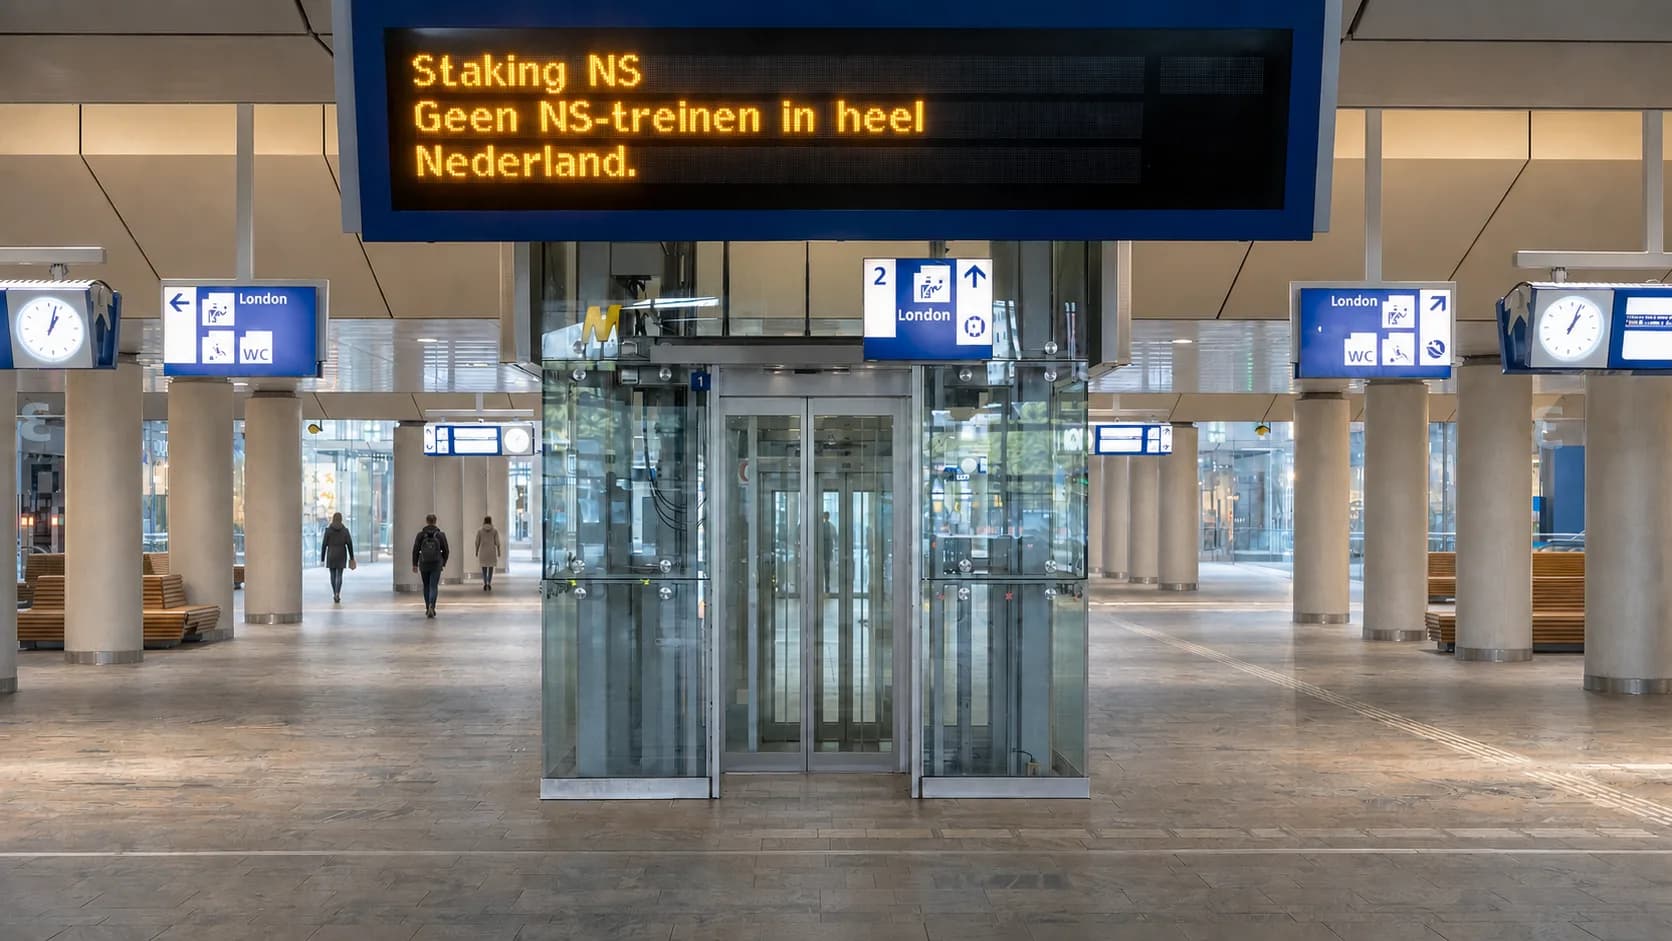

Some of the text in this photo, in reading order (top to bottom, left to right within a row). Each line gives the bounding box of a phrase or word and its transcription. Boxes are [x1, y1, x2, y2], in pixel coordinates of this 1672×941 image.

[413, 53, 641, 92] Staking NS
[413, 100, 925, 133] Geen NS-treinen in heel
[415, 144, 637, 177] Nederland.
[873, 266, 887, 286] 2
[239, 292, 288, 305] London
[1331, 294, 1378, 307] London
[898, 307, 951, 322] London
[243, 348, 268, 361] WC
[1347, 349, 1373, 362] WC
